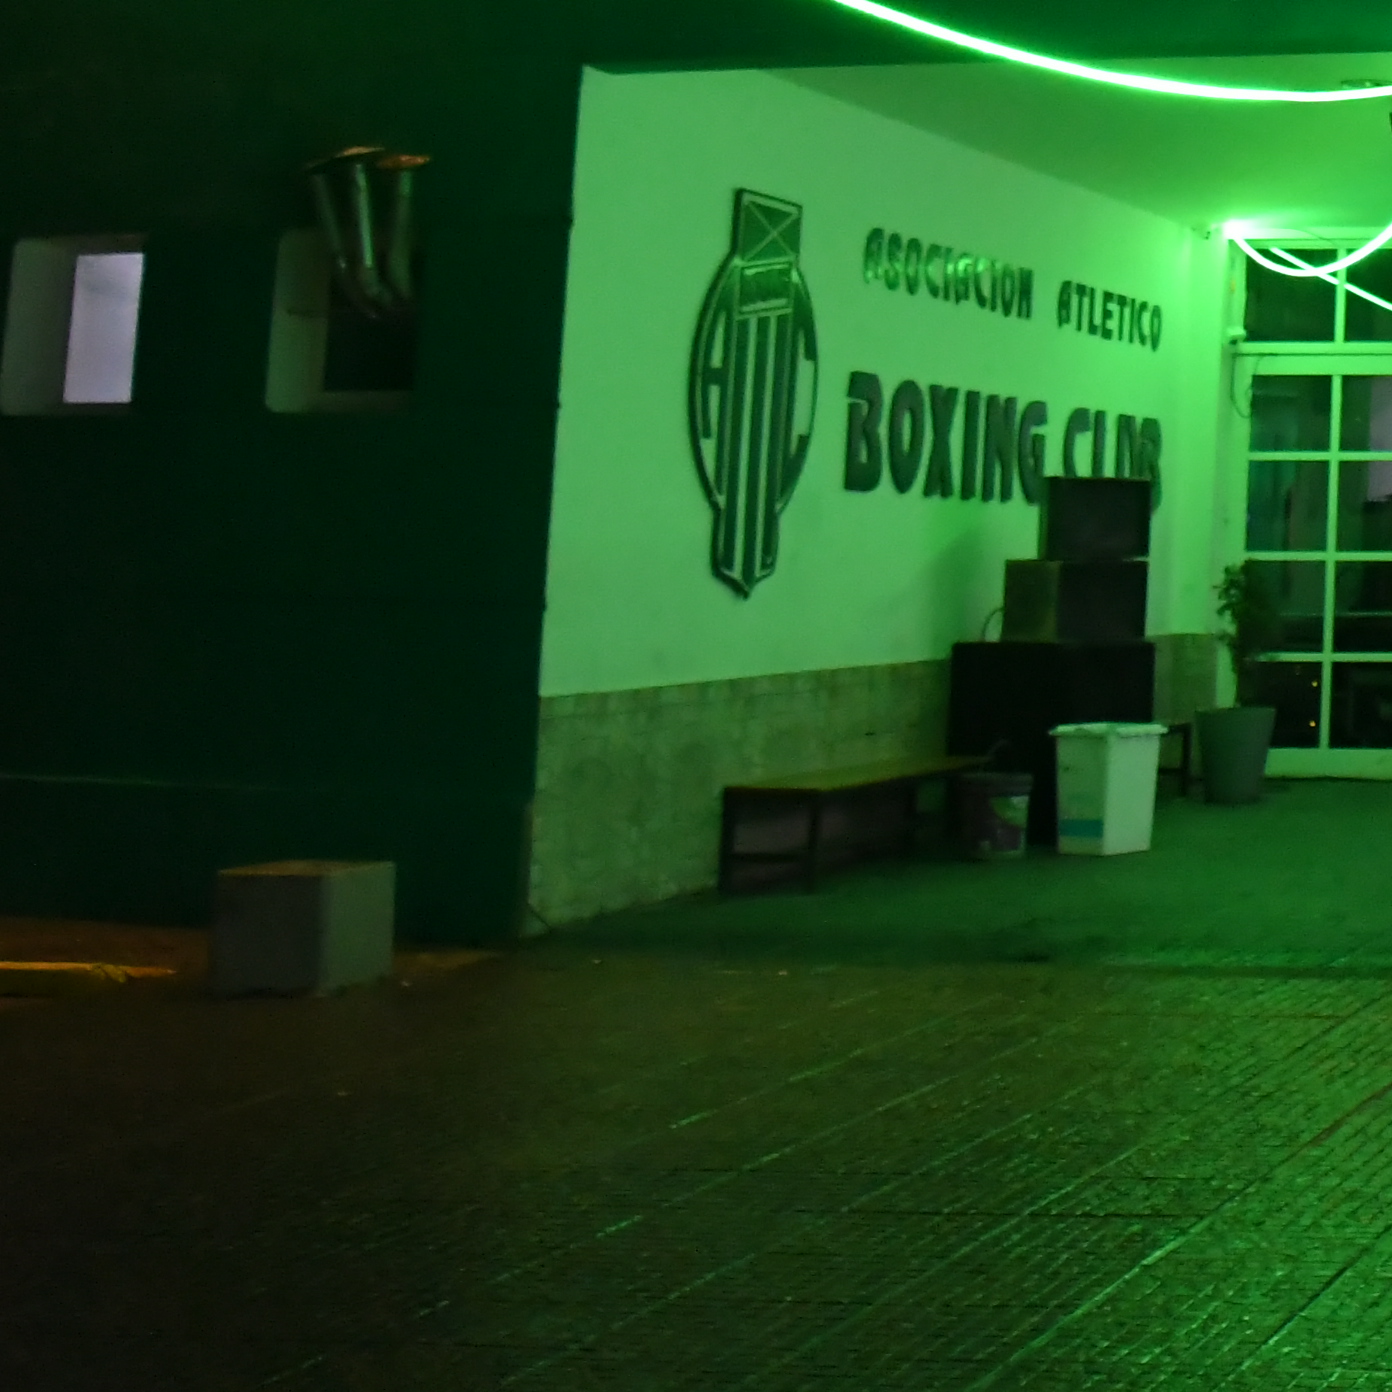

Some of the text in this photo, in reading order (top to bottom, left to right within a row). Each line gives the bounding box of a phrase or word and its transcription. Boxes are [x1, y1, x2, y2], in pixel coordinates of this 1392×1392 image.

[862, 227, 1162, 352] ASOCIACION ATLETICO
[844, 370, 1049, 507] BOXING
